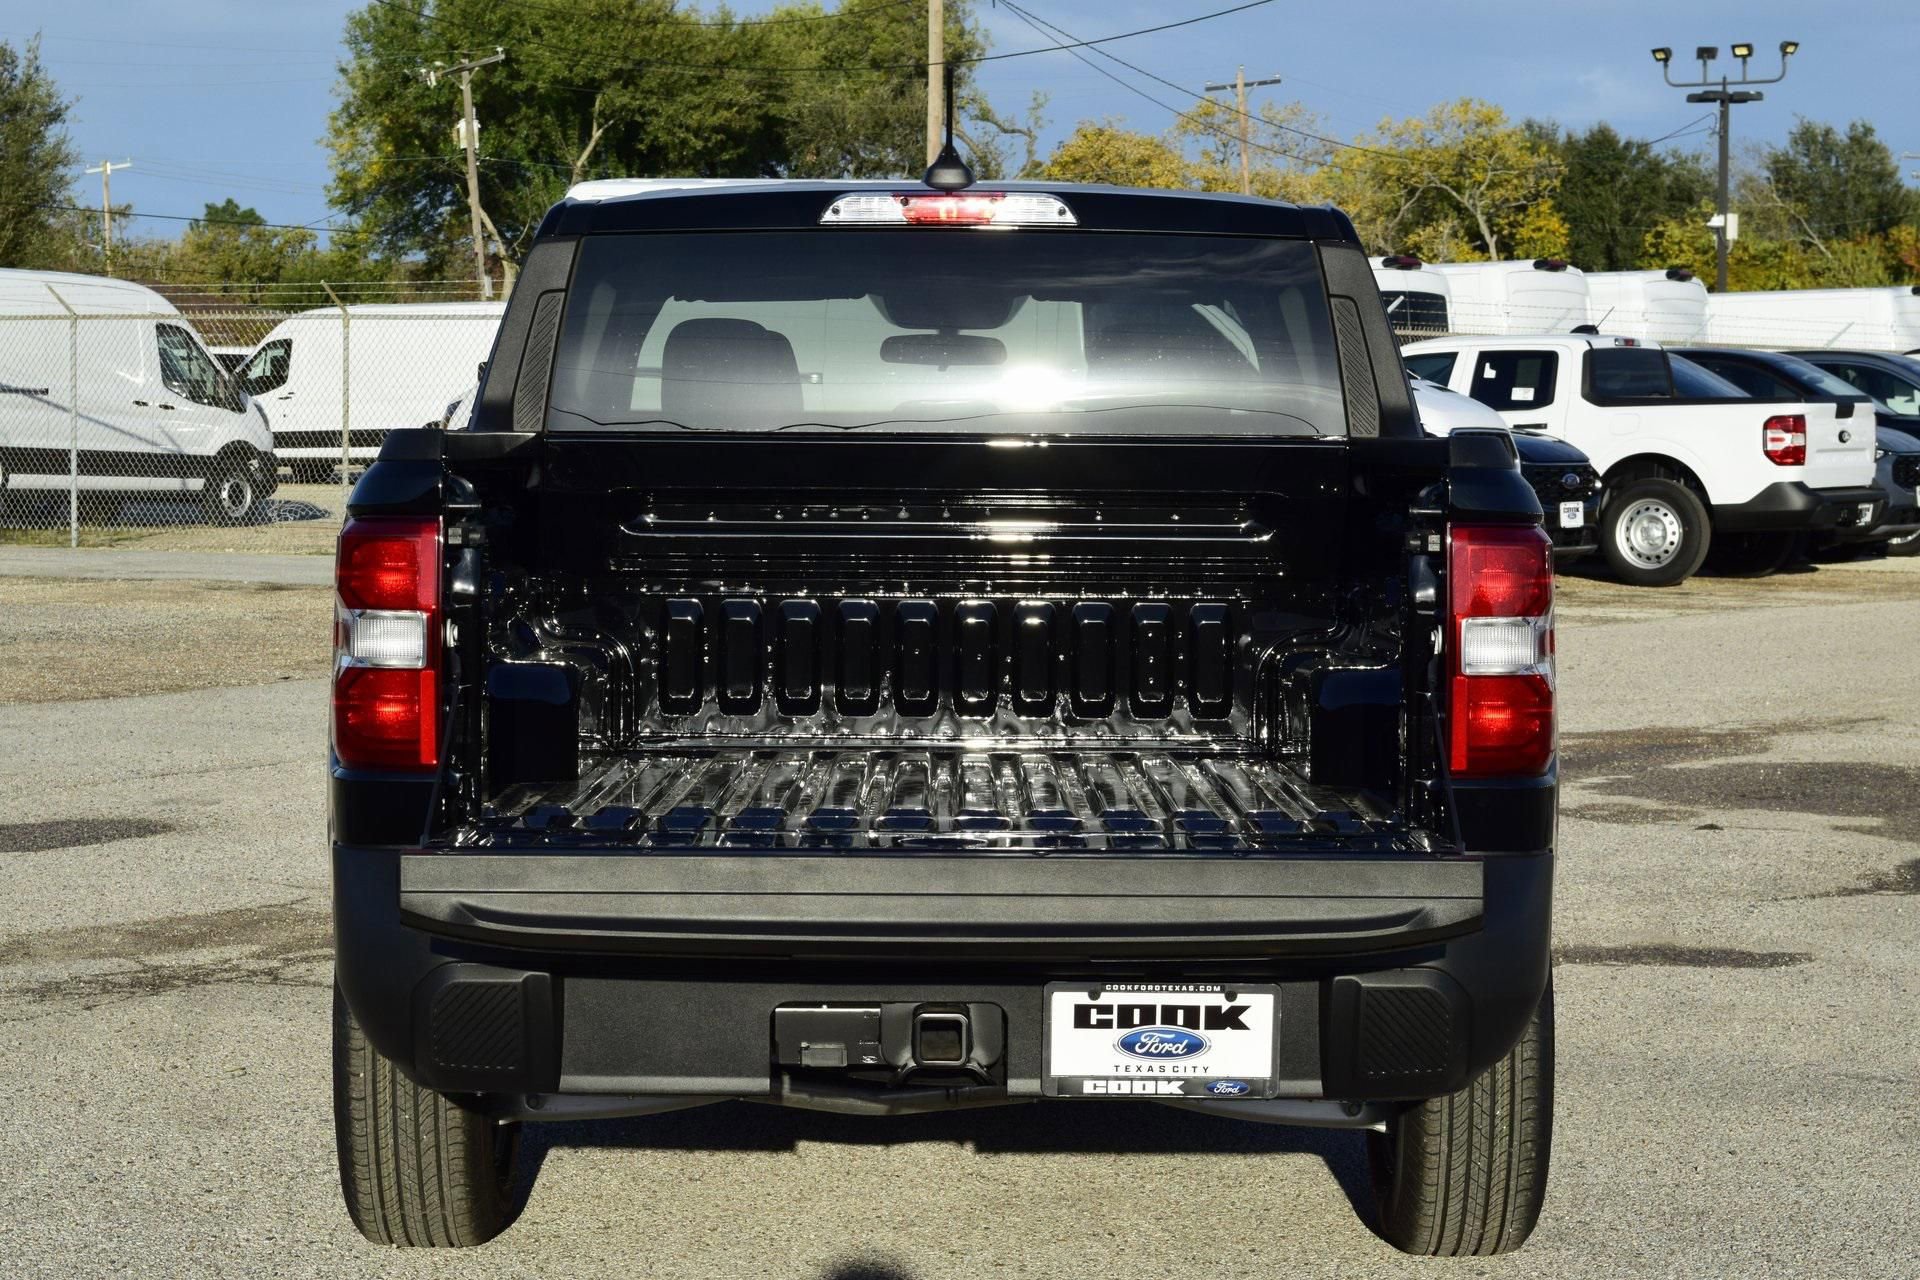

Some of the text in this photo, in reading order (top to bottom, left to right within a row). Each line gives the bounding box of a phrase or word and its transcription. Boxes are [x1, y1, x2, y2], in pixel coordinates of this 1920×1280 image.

[1105, 984, 1222, 992] COOKFORDTEXAS.COM
[1073, 1003, 1251, 1031] COOK
[1134, 1032, 1188, 1055] Ford
[1114, 1064, 1210, 1074] TEXAS CITY
[1082, 1080, 1185, 1095] COOK
[1213, 1080, 1240, 1095] Ford
